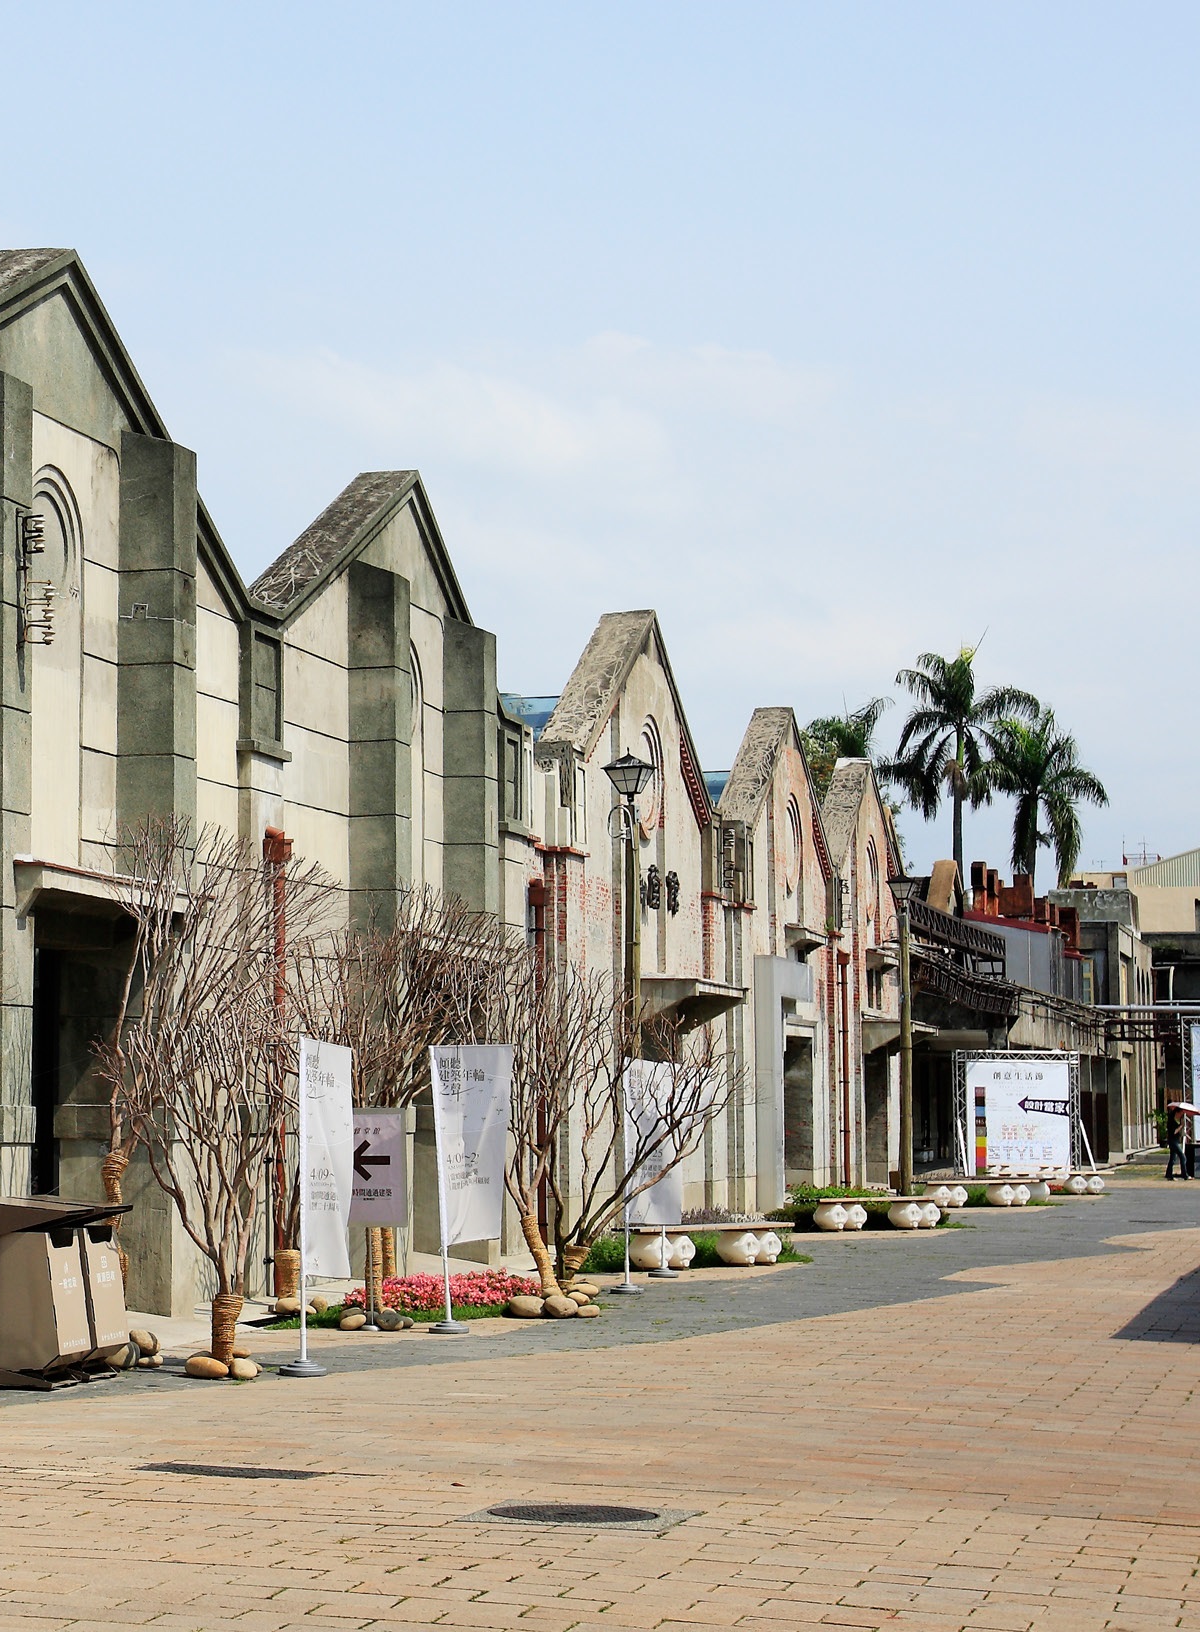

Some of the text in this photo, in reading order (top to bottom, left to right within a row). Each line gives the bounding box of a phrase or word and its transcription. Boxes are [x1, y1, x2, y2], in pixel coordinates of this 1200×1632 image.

[440, 1057, 461, 1069] 傾聽
[439, 1069, 485, 1082] 建築年輪
